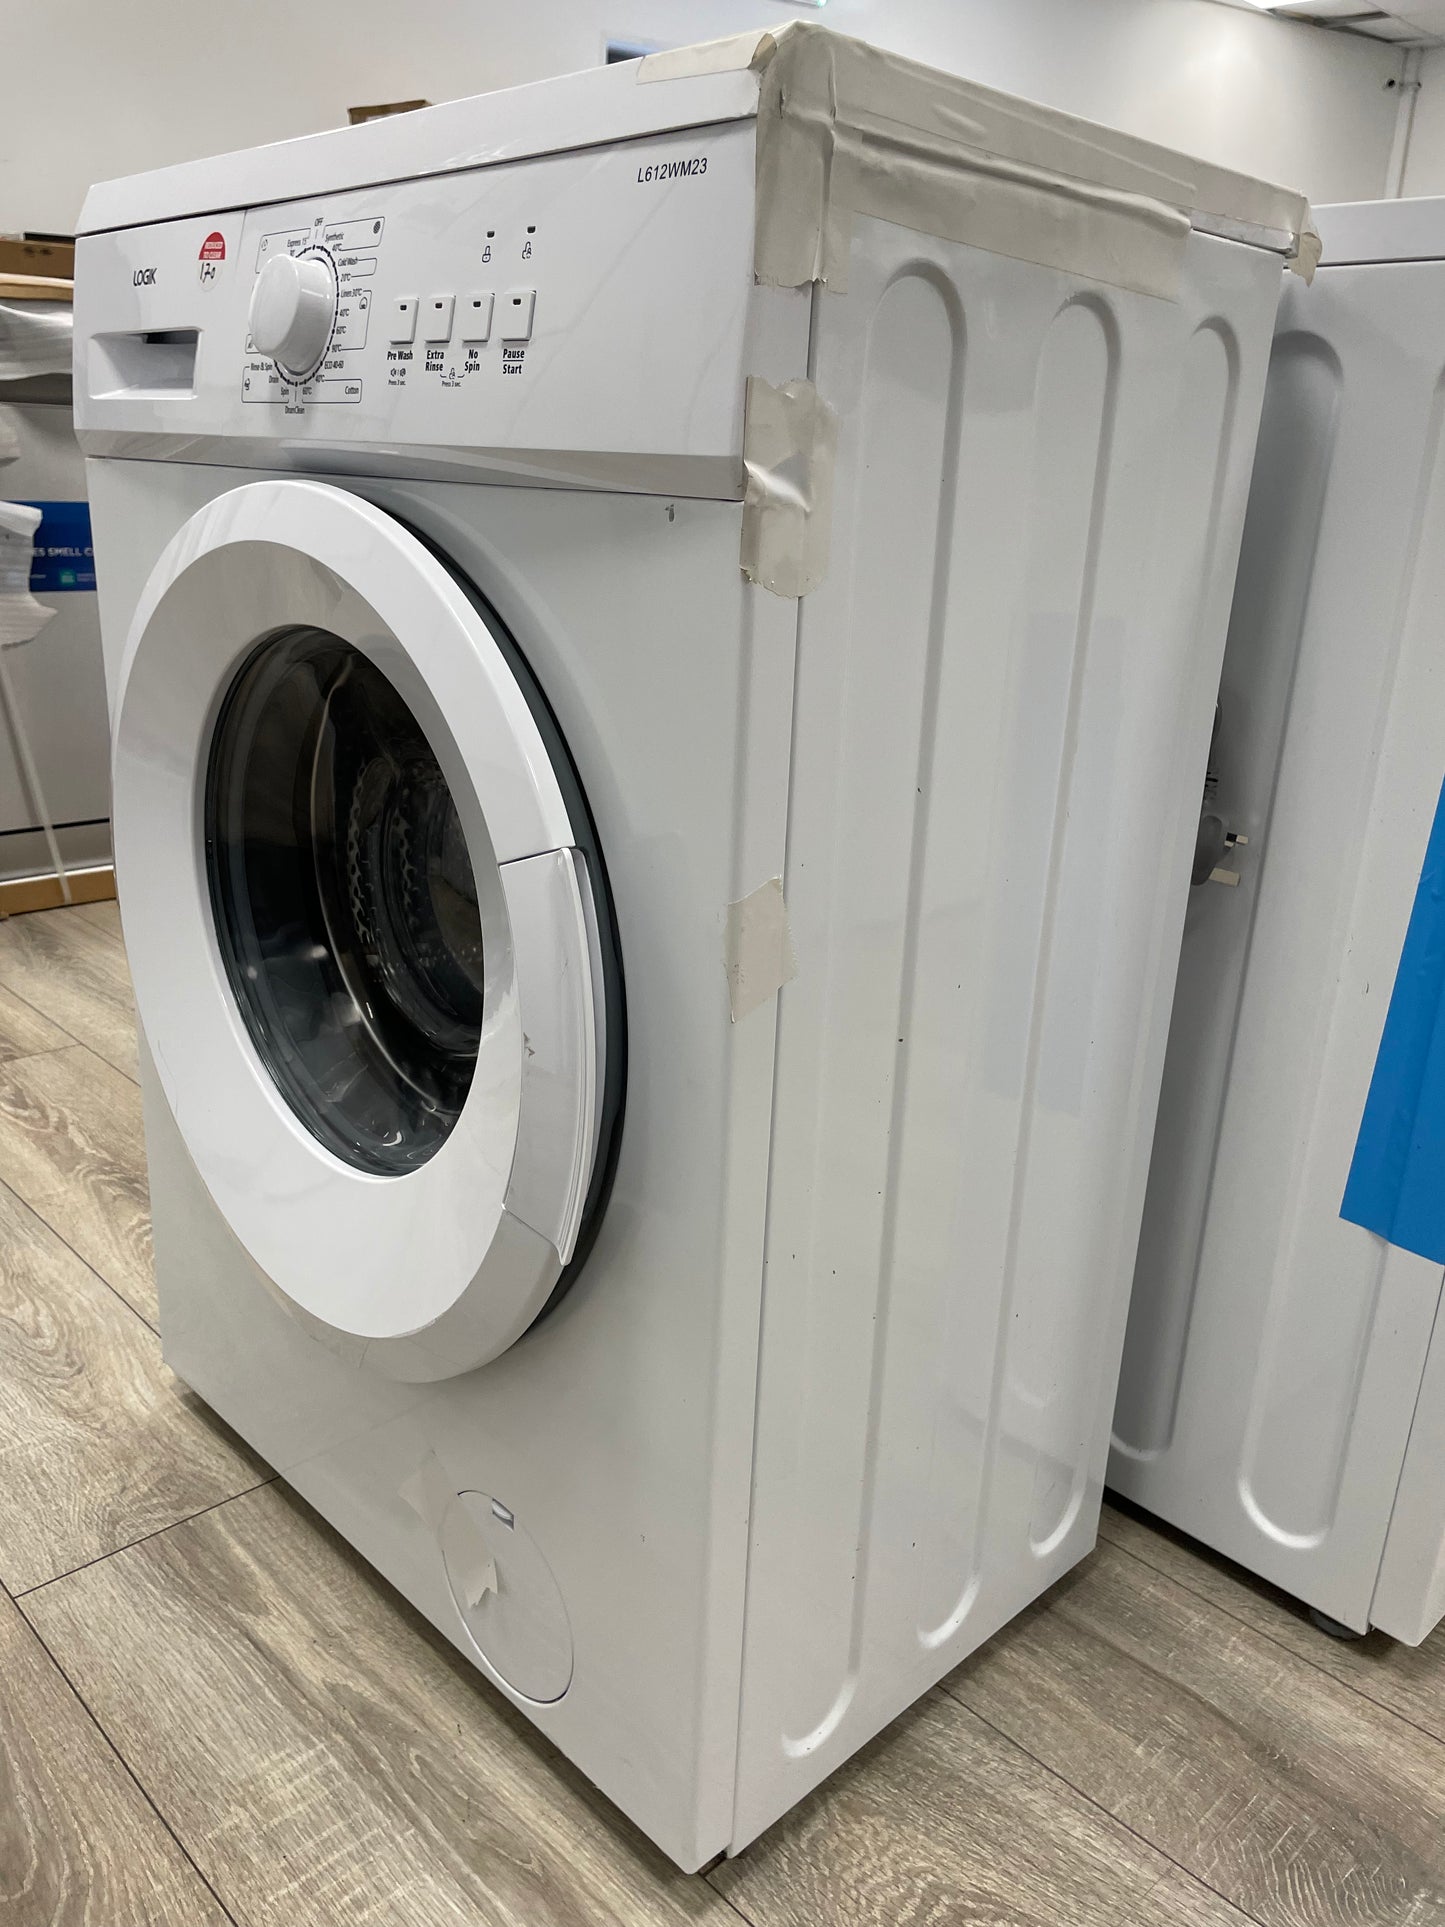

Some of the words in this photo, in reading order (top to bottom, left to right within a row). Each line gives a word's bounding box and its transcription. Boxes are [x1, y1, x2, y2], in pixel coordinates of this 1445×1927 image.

[637, 157, 708, 183] L612WM23
[314, 217, 323, 227] OFF
[325, 233, 344, 242] Synthetic
[287, 239, 301, 248] Express
[338, 258, 348, 266] Cold
[348, 256, 358, 265] Wash
[133, 267, 158, 287] LOGIK
[340, 290, 352, 298] Linen
[387, 351, 397, 360] Pre
[397, 350, 414, 360] Wash
[426, 350, 445, 359] Extra
[468, 349, 479, 359] No
[502, 348, 525, 359] Pause
[265, 363, 273, 372] Spin
[324, 361, 333, 369] ECO
[333, 360, 344, 368] 40-60
[425, 361, 443, 371] Rinse
[464, 361, 481, 373] Spin
[502, 364, 522, 374] Start
[268, 375, 279, 383] Drain
[280, 387, 289, 396] Spin
[344, 385, 359, 395] Cotton
[47, 547, 82, 557] SMELL
